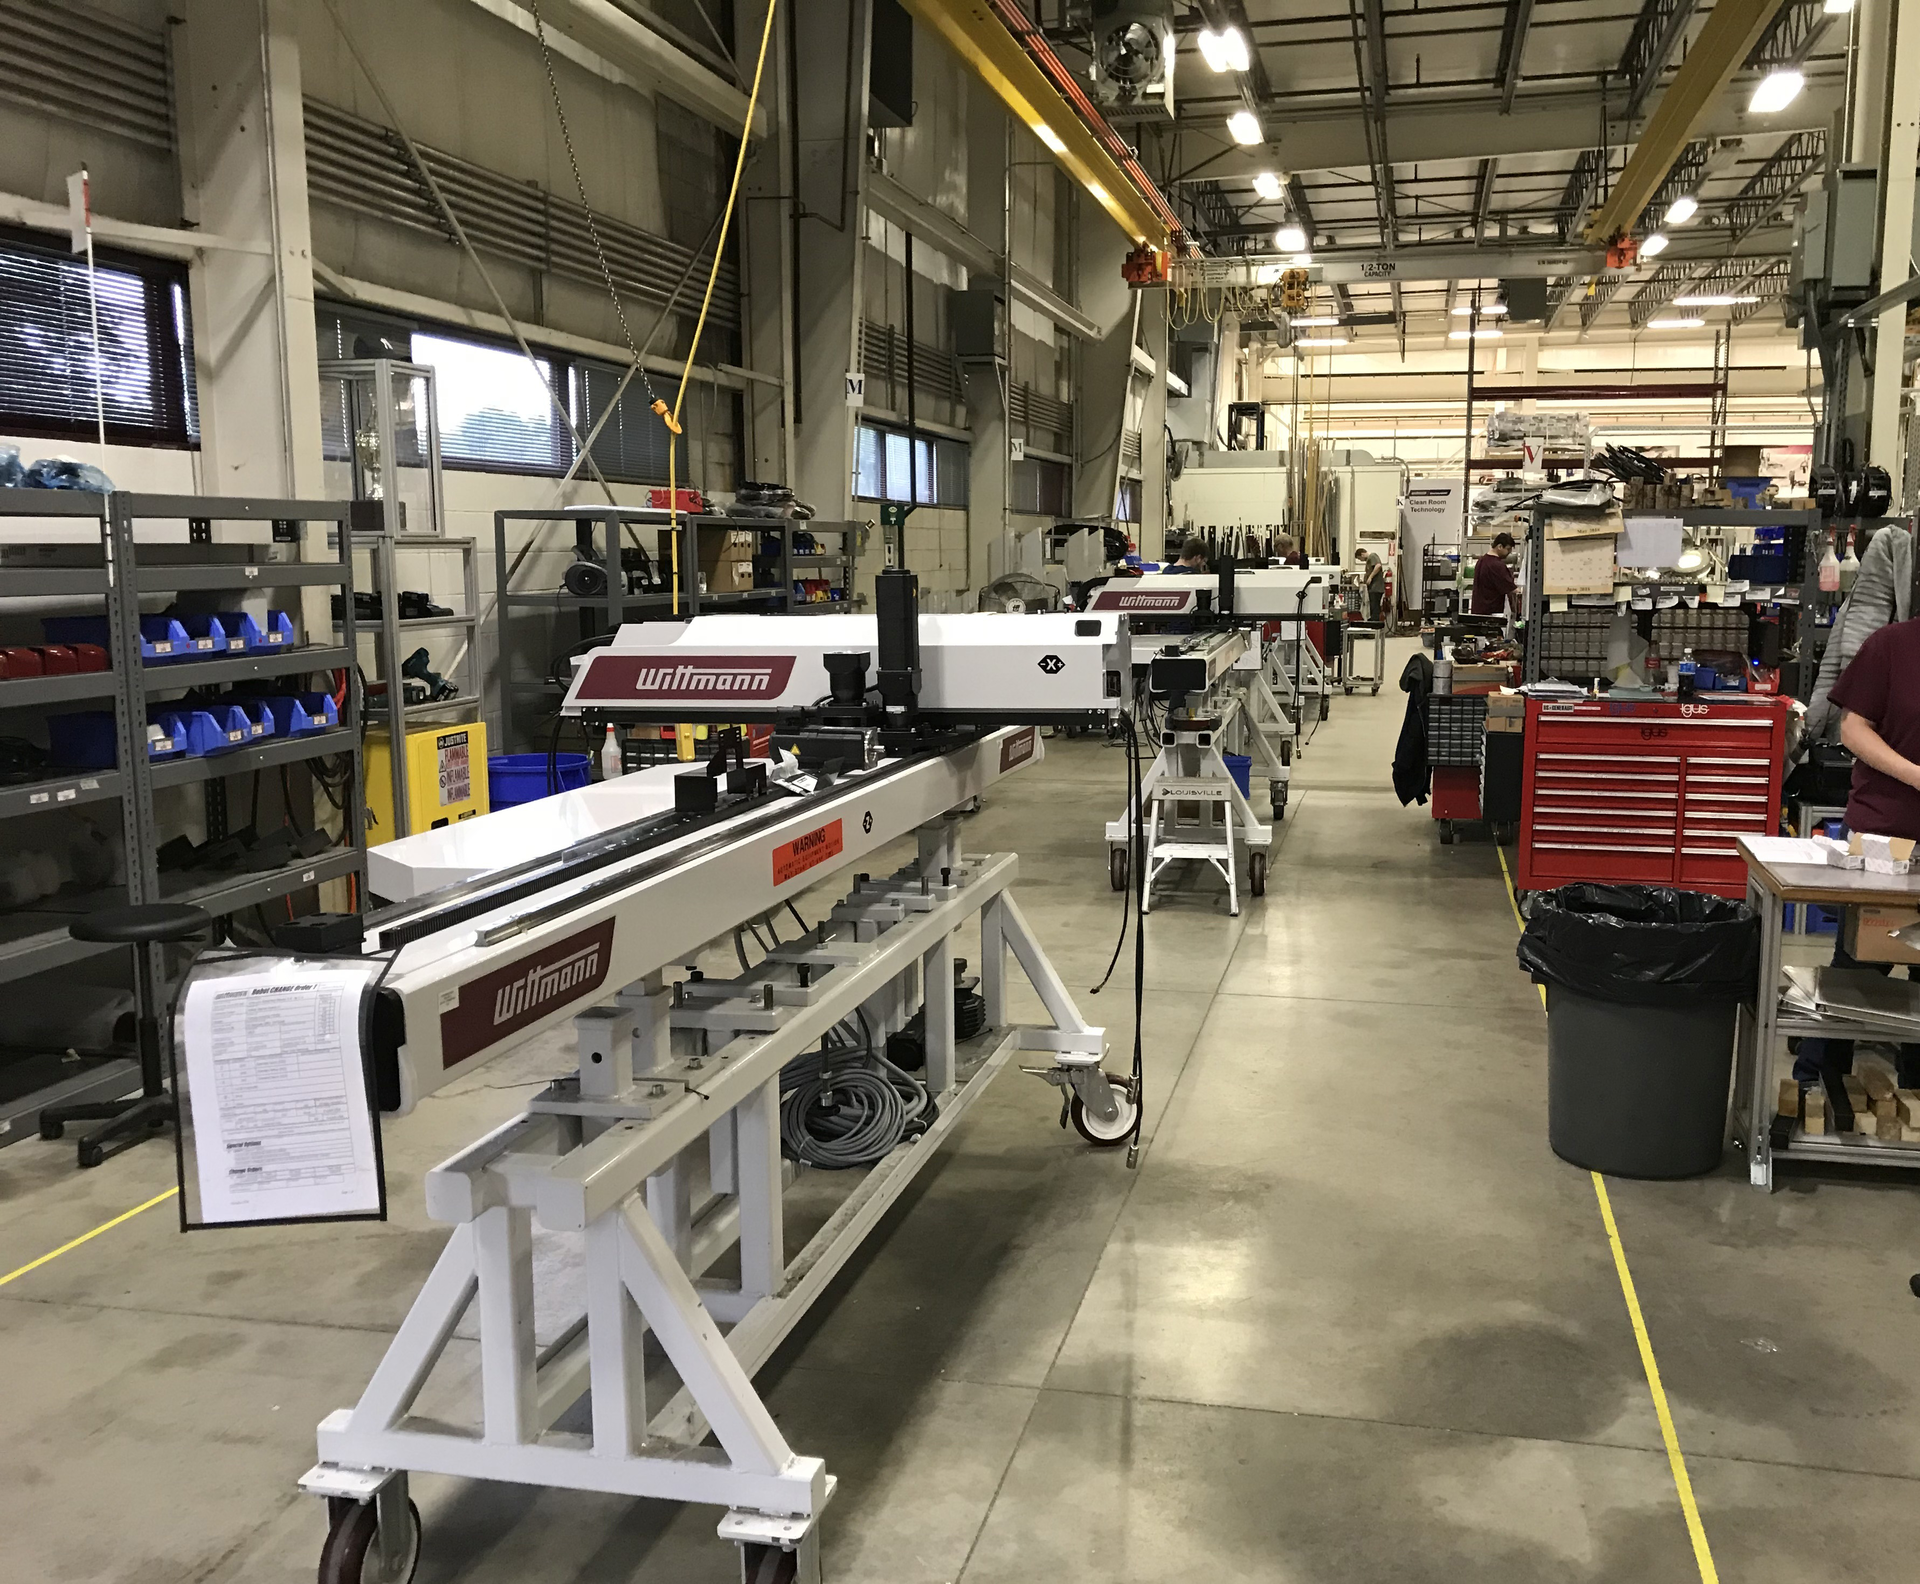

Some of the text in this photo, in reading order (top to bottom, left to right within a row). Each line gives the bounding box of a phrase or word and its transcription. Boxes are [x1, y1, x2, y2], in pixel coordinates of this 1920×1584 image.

[1360, 262, 1396, 271] 1/2-TON
[847, 379, 863, 395] M
[1011, 445, 1022, 454] M
[1524, 445, 1541, 464] V
[1119, 594, 1180, 607] Wittmann
[635, 665, 772, 690] Wittmann
[444, 733, 467, 747] JUSTRITE
[444, 744, 469, 763] FLAMMABLE
[792, 828, 826, 856] WARNING
[270, 985, 294, 993] CHANGE
[493, 942, 600, 1026] Wittmann
